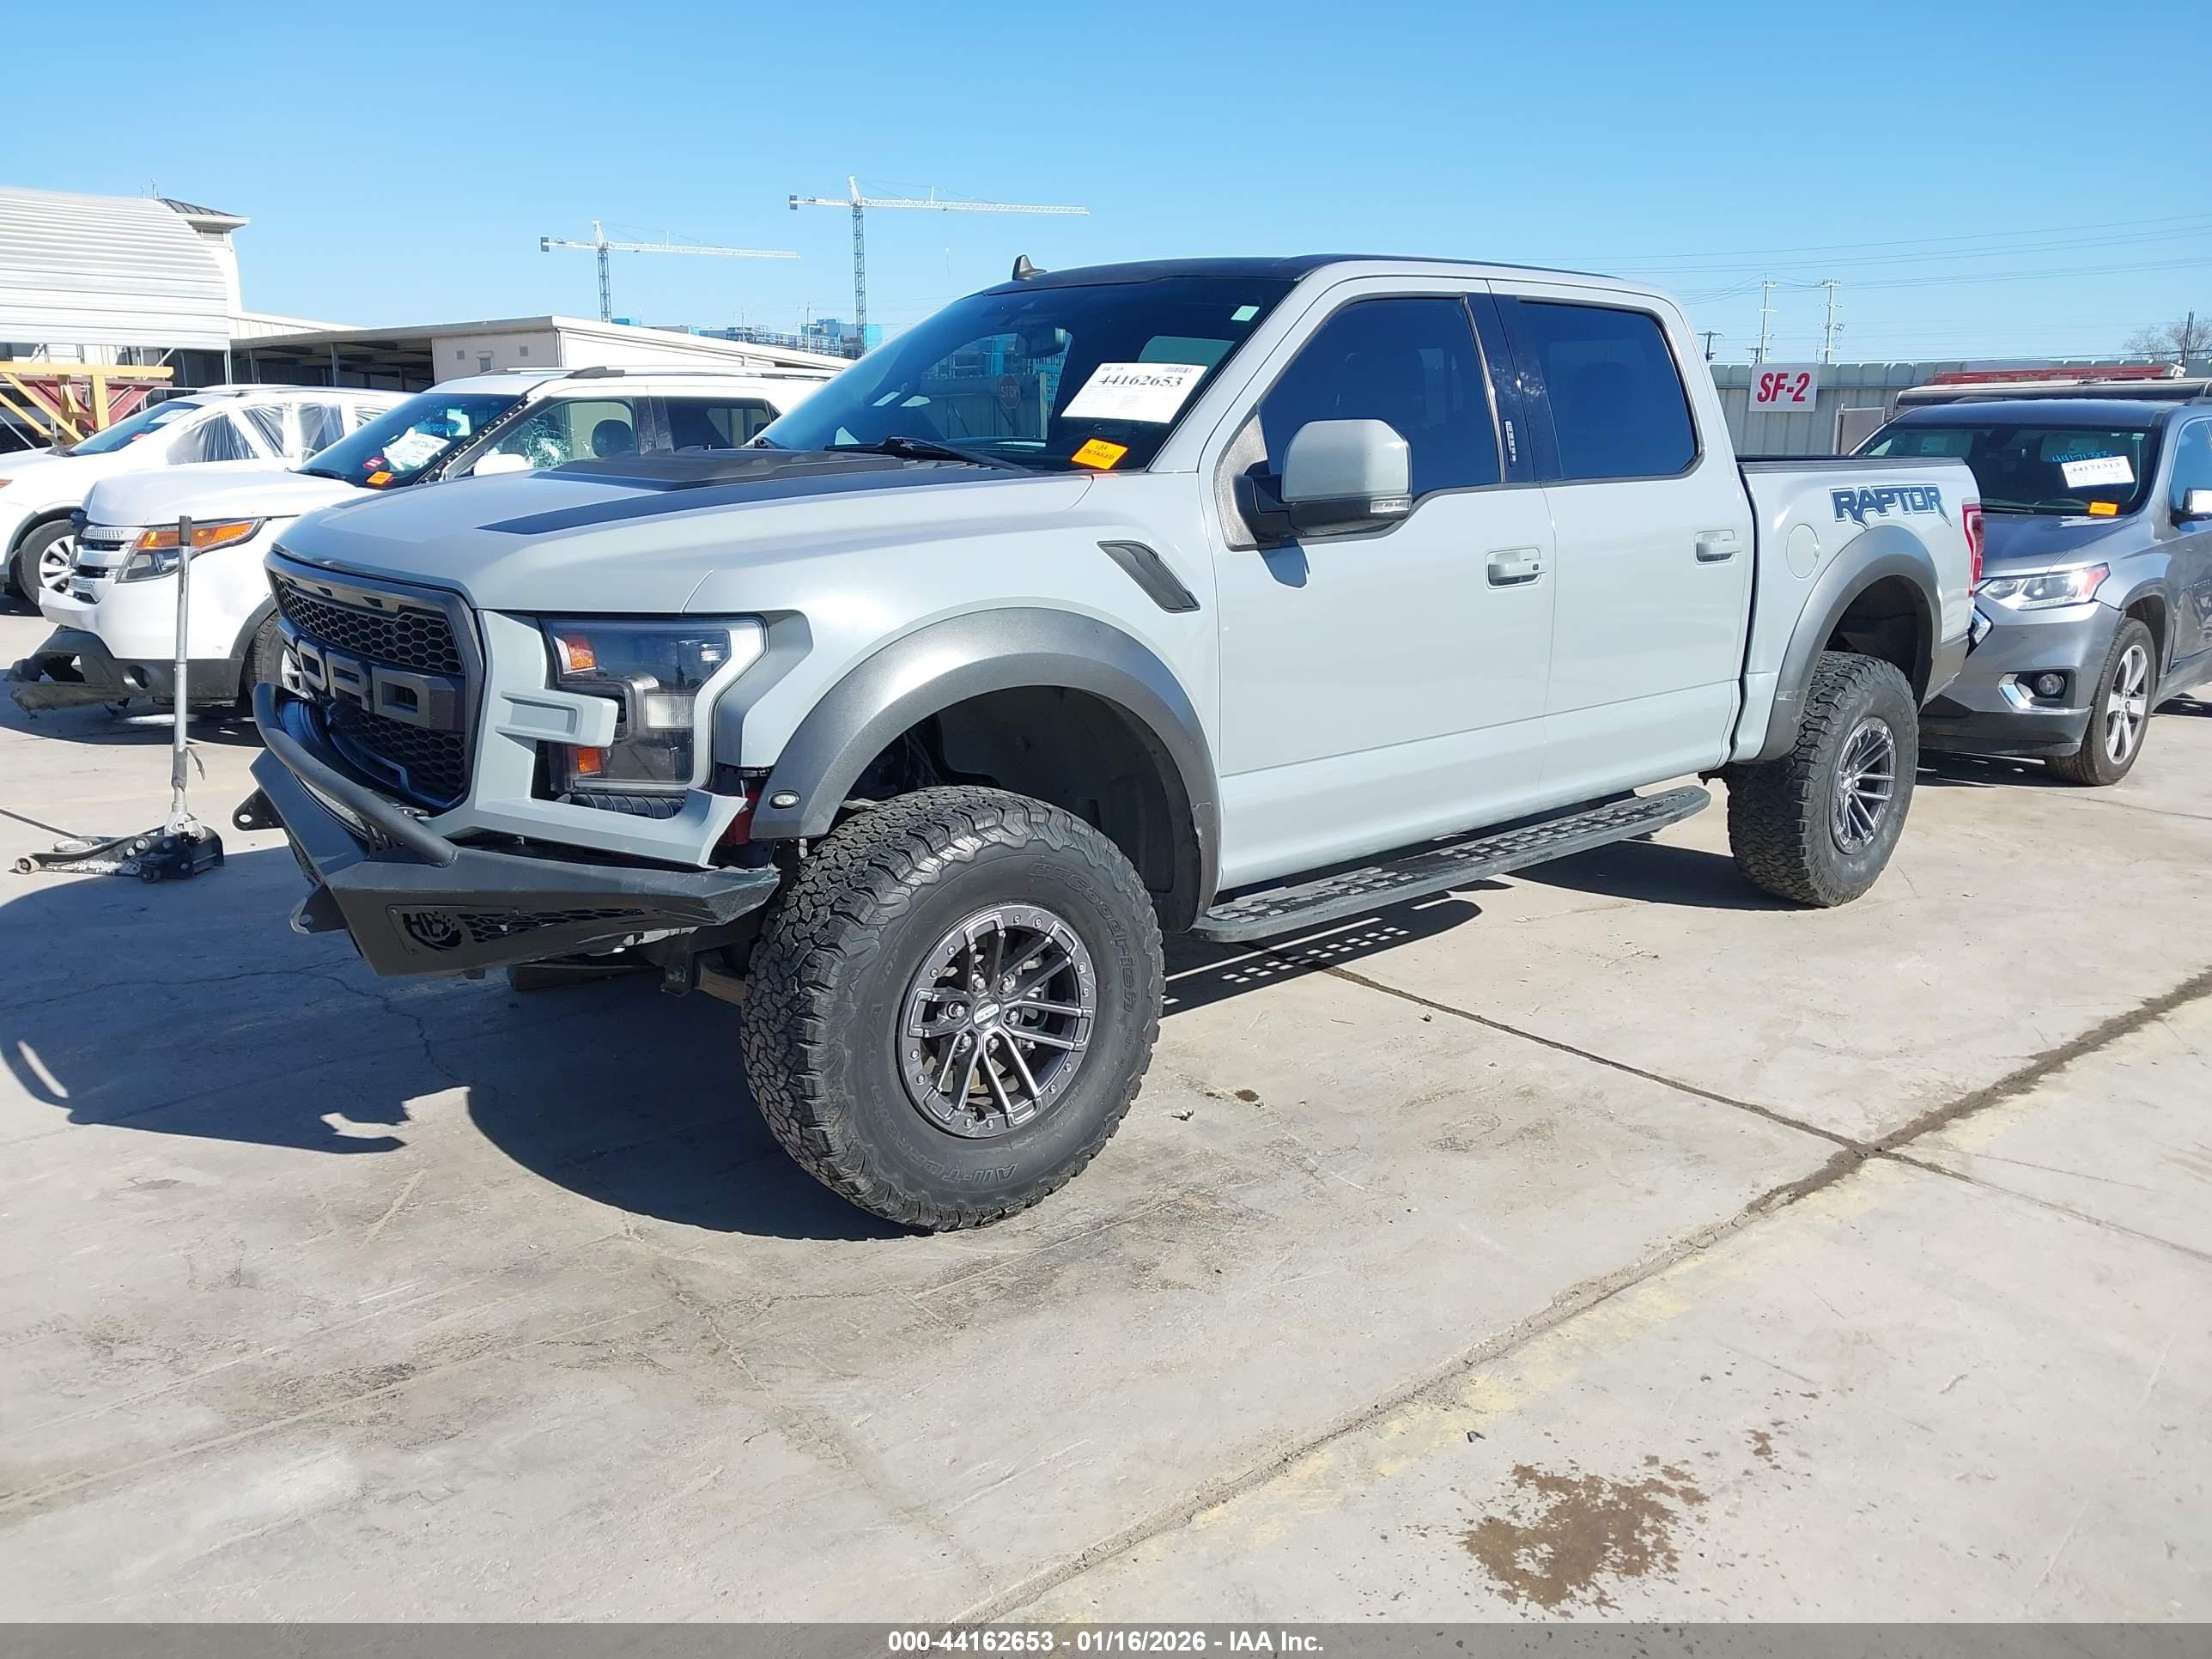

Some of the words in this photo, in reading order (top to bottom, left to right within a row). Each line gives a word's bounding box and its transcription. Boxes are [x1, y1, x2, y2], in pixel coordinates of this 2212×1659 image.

[1000, 385, 1018, 398] STOP
[1098, 374, 1183, 388] 44162653
[1756, 373, 1811, 403] SF-2
[1829, 483, 1952, 530] RAPTOR
